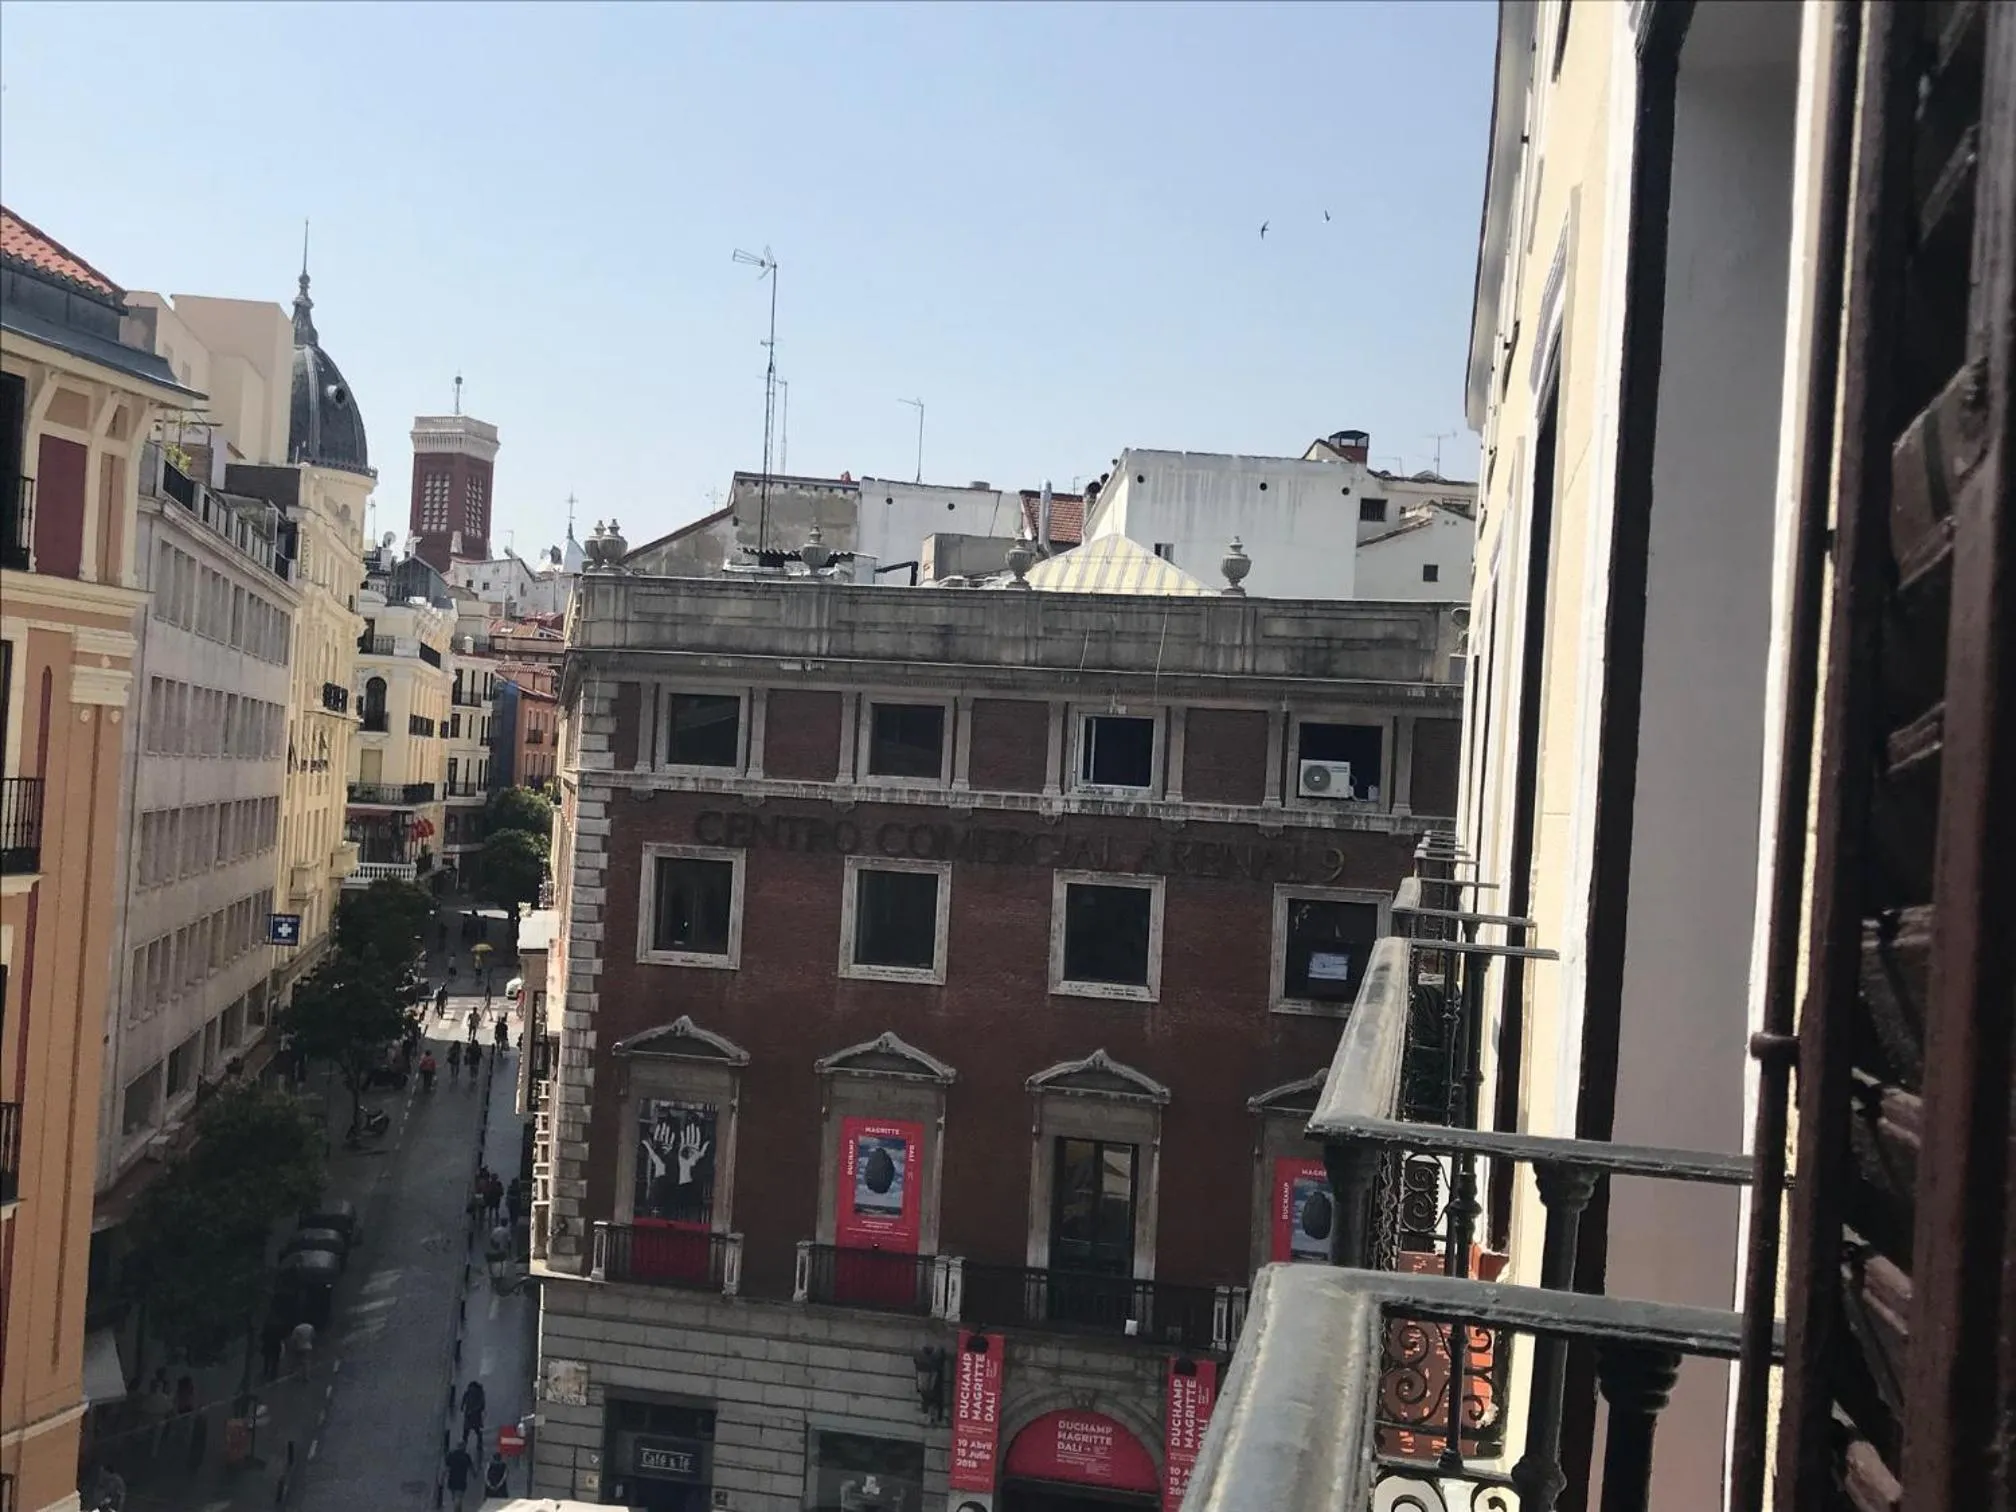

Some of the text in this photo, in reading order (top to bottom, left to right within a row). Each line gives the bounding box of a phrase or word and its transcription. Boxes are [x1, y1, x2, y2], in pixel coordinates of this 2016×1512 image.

[695, 809, 1346, 882] CENTRO COMERCIAL ARENAL 9
[865, 1127, 900, 1135] MAGRITTE
[1301, 1169, 1327, 1177] MAGRI
[960, 1353, 972, 1418] DUCHAMP
[972, 1354, 986, 1420] MAGRITTE
[984, 1390, 995, 1422] DALÍ
[1171, 1379, 1183, 1447] DUCHAMP
[1184, 1379, 1196, 1449] MAGRITTE
[1058, 1420, 1112, 1434] DUCHAMP
[1057, 1431, 1112, 1446] MAGRITTE
[956, 1458, 978, 1468] 2018
[1170, 1466, 1181, 1475] 10
[1169, 1487, 1186, 1496] 201
